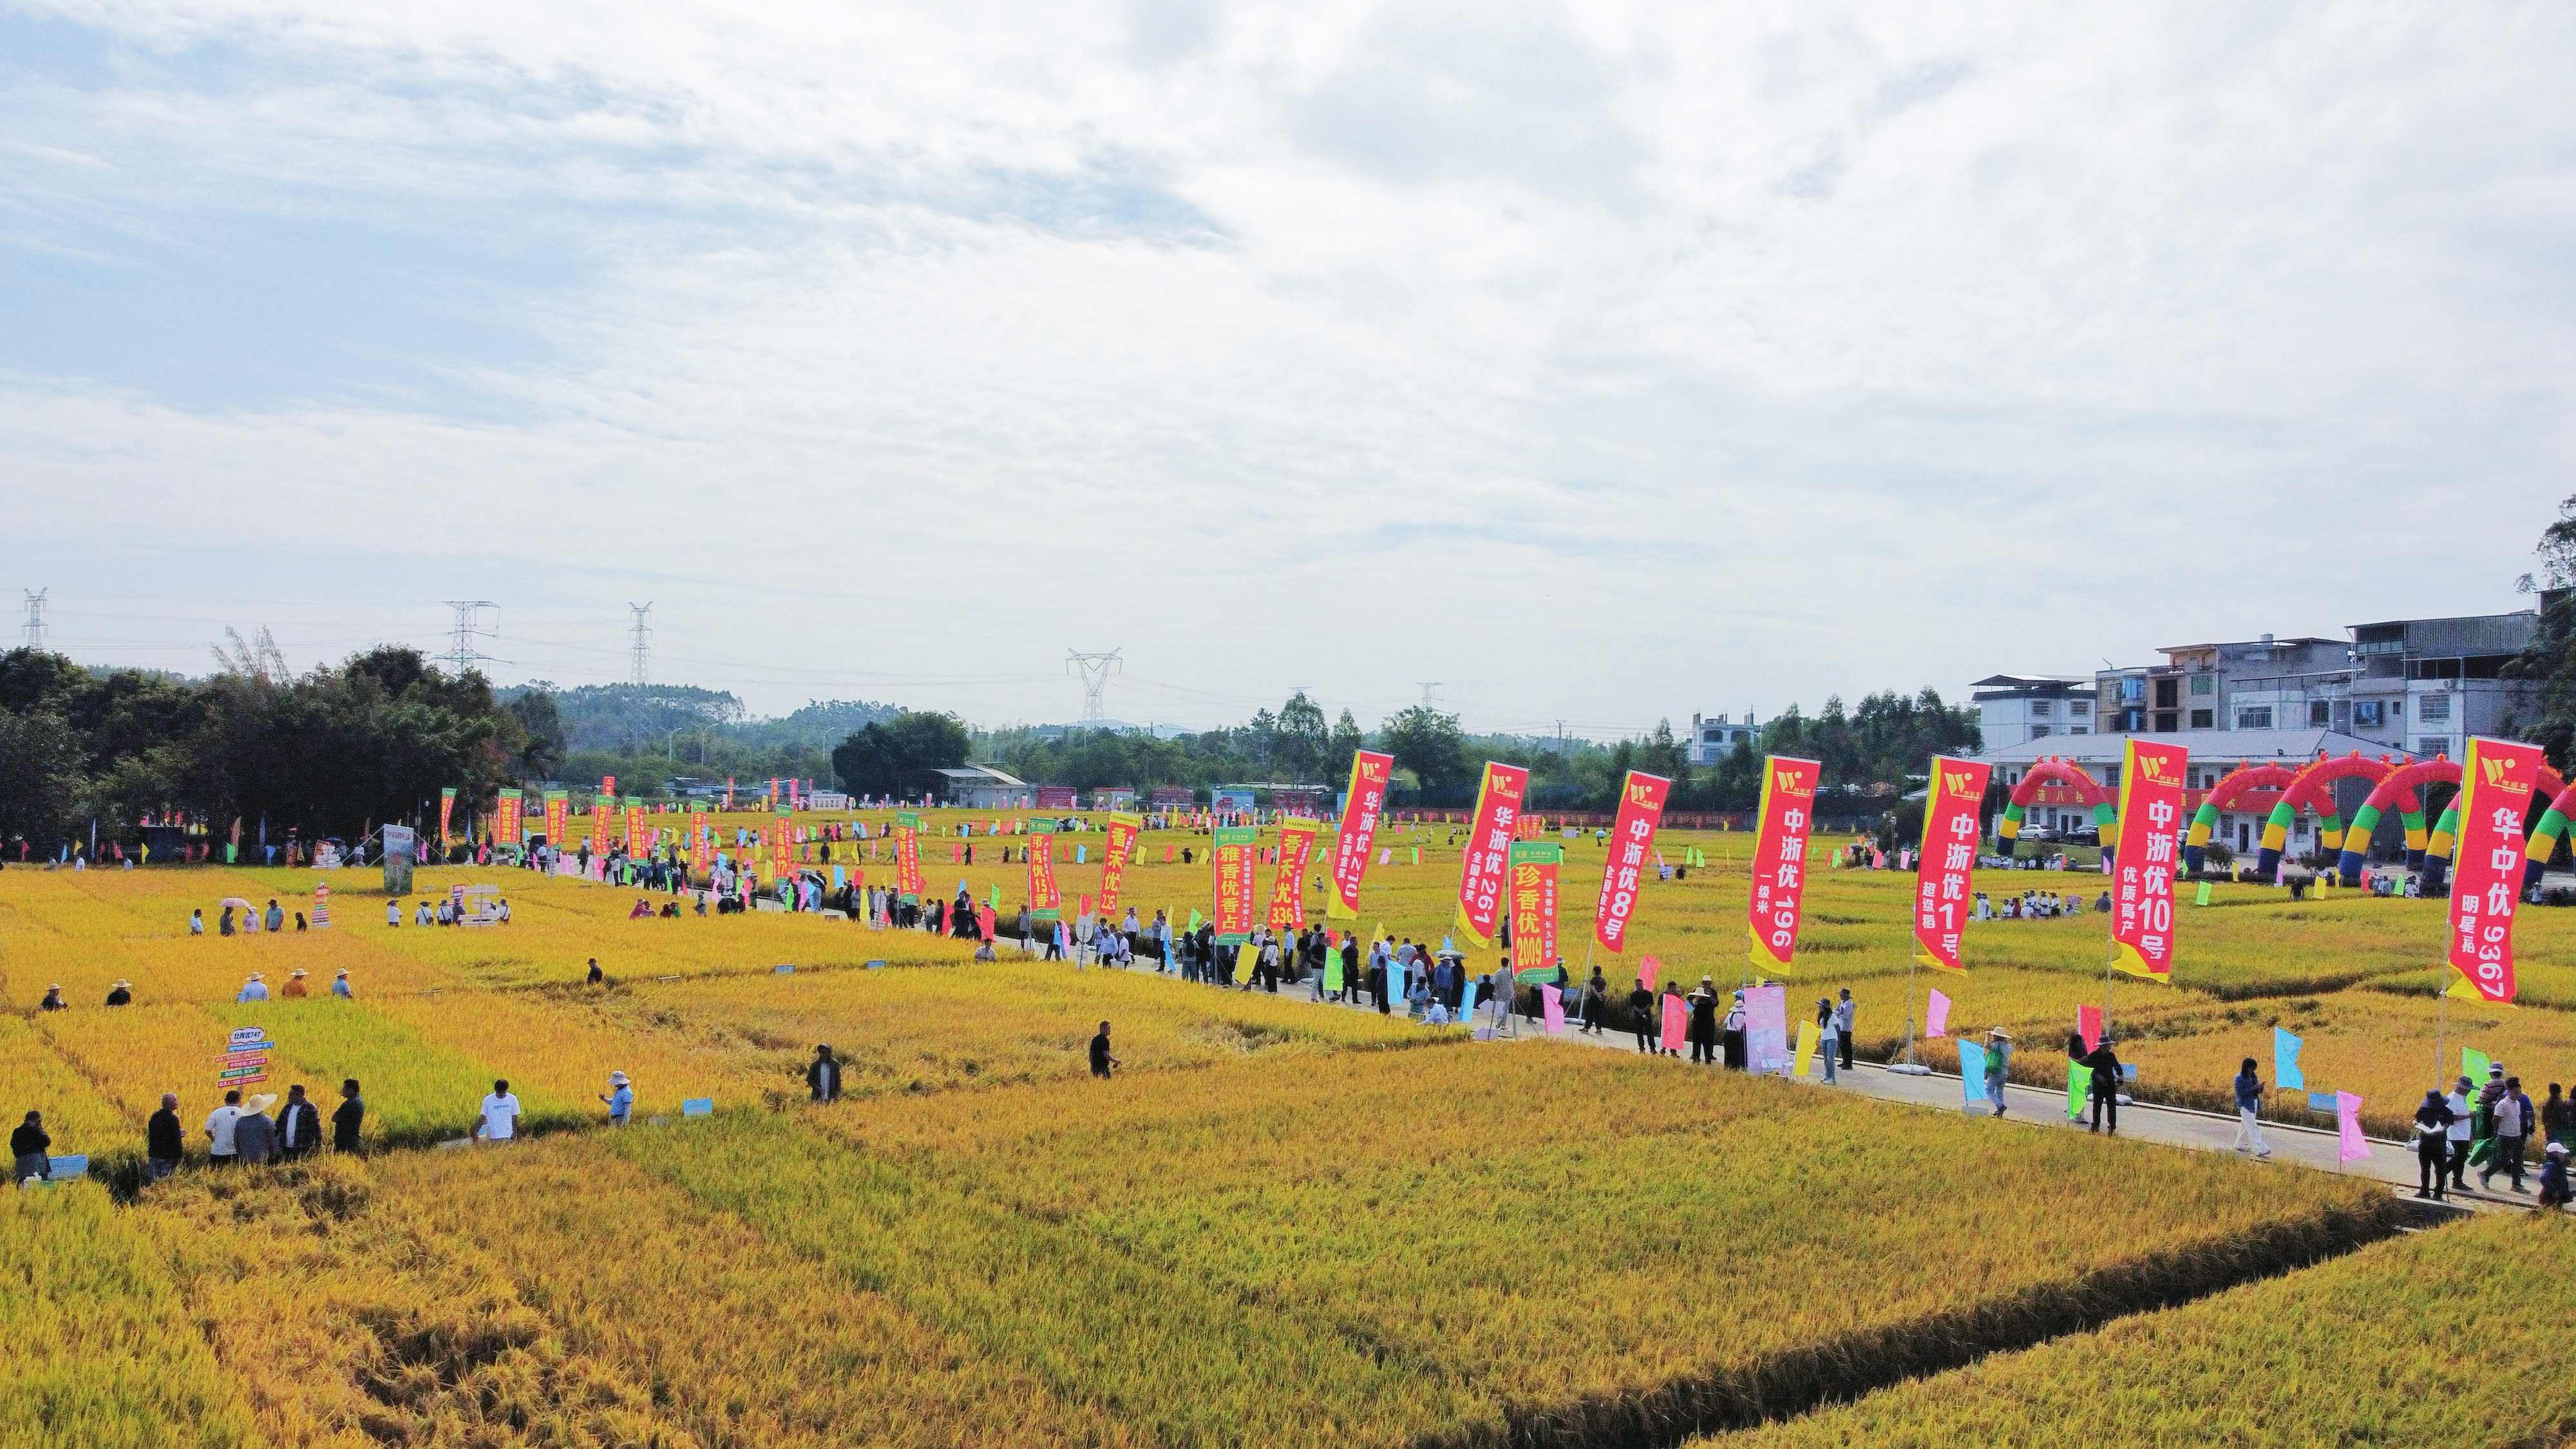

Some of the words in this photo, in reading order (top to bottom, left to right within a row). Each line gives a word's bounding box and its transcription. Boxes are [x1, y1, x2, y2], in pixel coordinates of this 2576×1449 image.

[1220, 847, 1240, 930] 雅香优香占
[1271, 834, 1303, 924] 香禾优336
[1336, 833, 1353, 879] 全国金奖
[1464, 851, 1482, 902] 全国金奖
[1473, 806, 1513, 925] 华浙优261
[1604, 819, 1650, 940] 中浙优8号
[1756, 874, 1772, 914] 一级米
[1772, 808, 1804, 947] 中浙优196
[1938, 813, 1975, 960] 中浙优1号
[2120, 866, 2138, 936] 优质高产
[2137, 799, 2174, 960] 中浙优10号
[1516, 865, 1542, 966] 珍香优2009
[1922, 881, 1937, 929] 超级稻
[2458, 895, 2480, 953] 明星稻
[2477, 806, 2523, 998] 华中优9367
